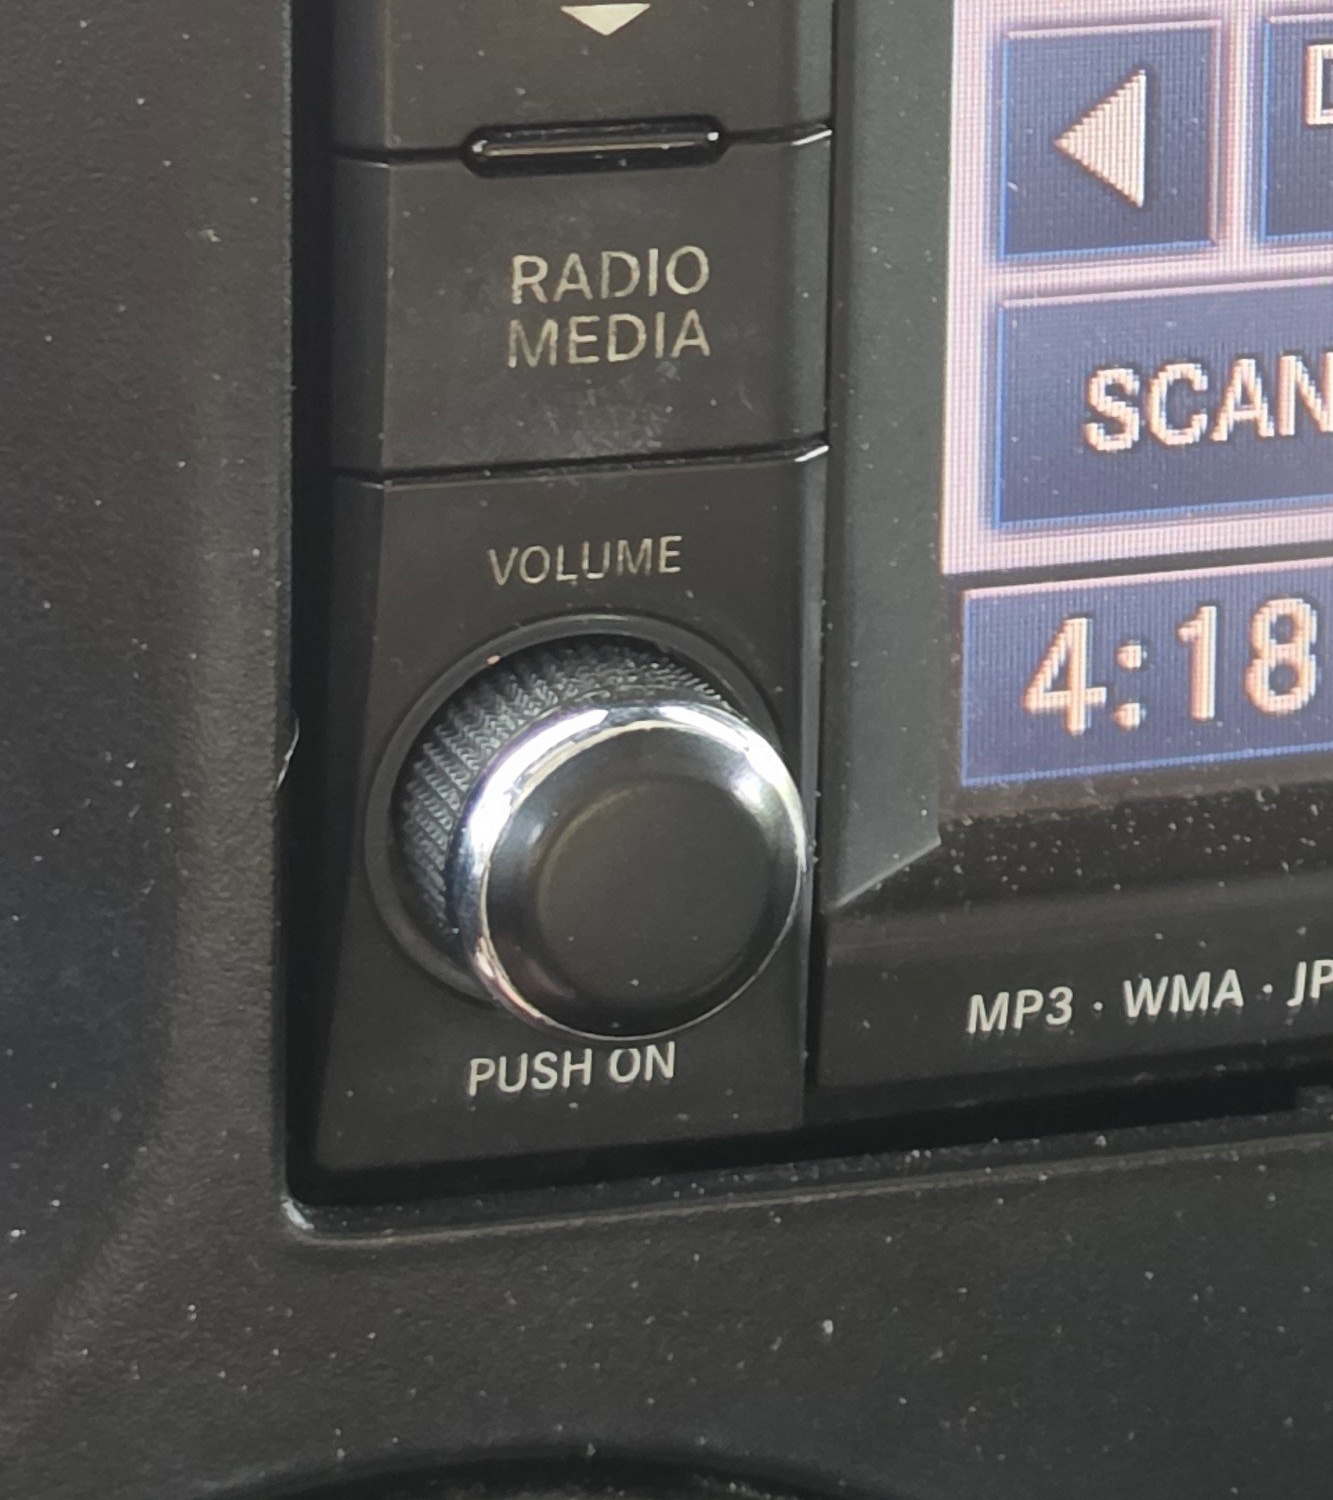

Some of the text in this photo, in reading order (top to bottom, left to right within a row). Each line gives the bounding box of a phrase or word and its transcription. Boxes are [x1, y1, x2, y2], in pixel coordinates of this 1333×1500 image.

[510, 244, 711, 306] RADIO
[505, 309, 712, 370] MEDIA
[487, 534, 683, 587] VOLUME
[1022, 595, 1322, 736] 4:18
[966, 984, 1075, 1036] MP3
[1121, 969, 1245, 1021] WMA
[466, 1040, 678, 1096] PUSH ON
